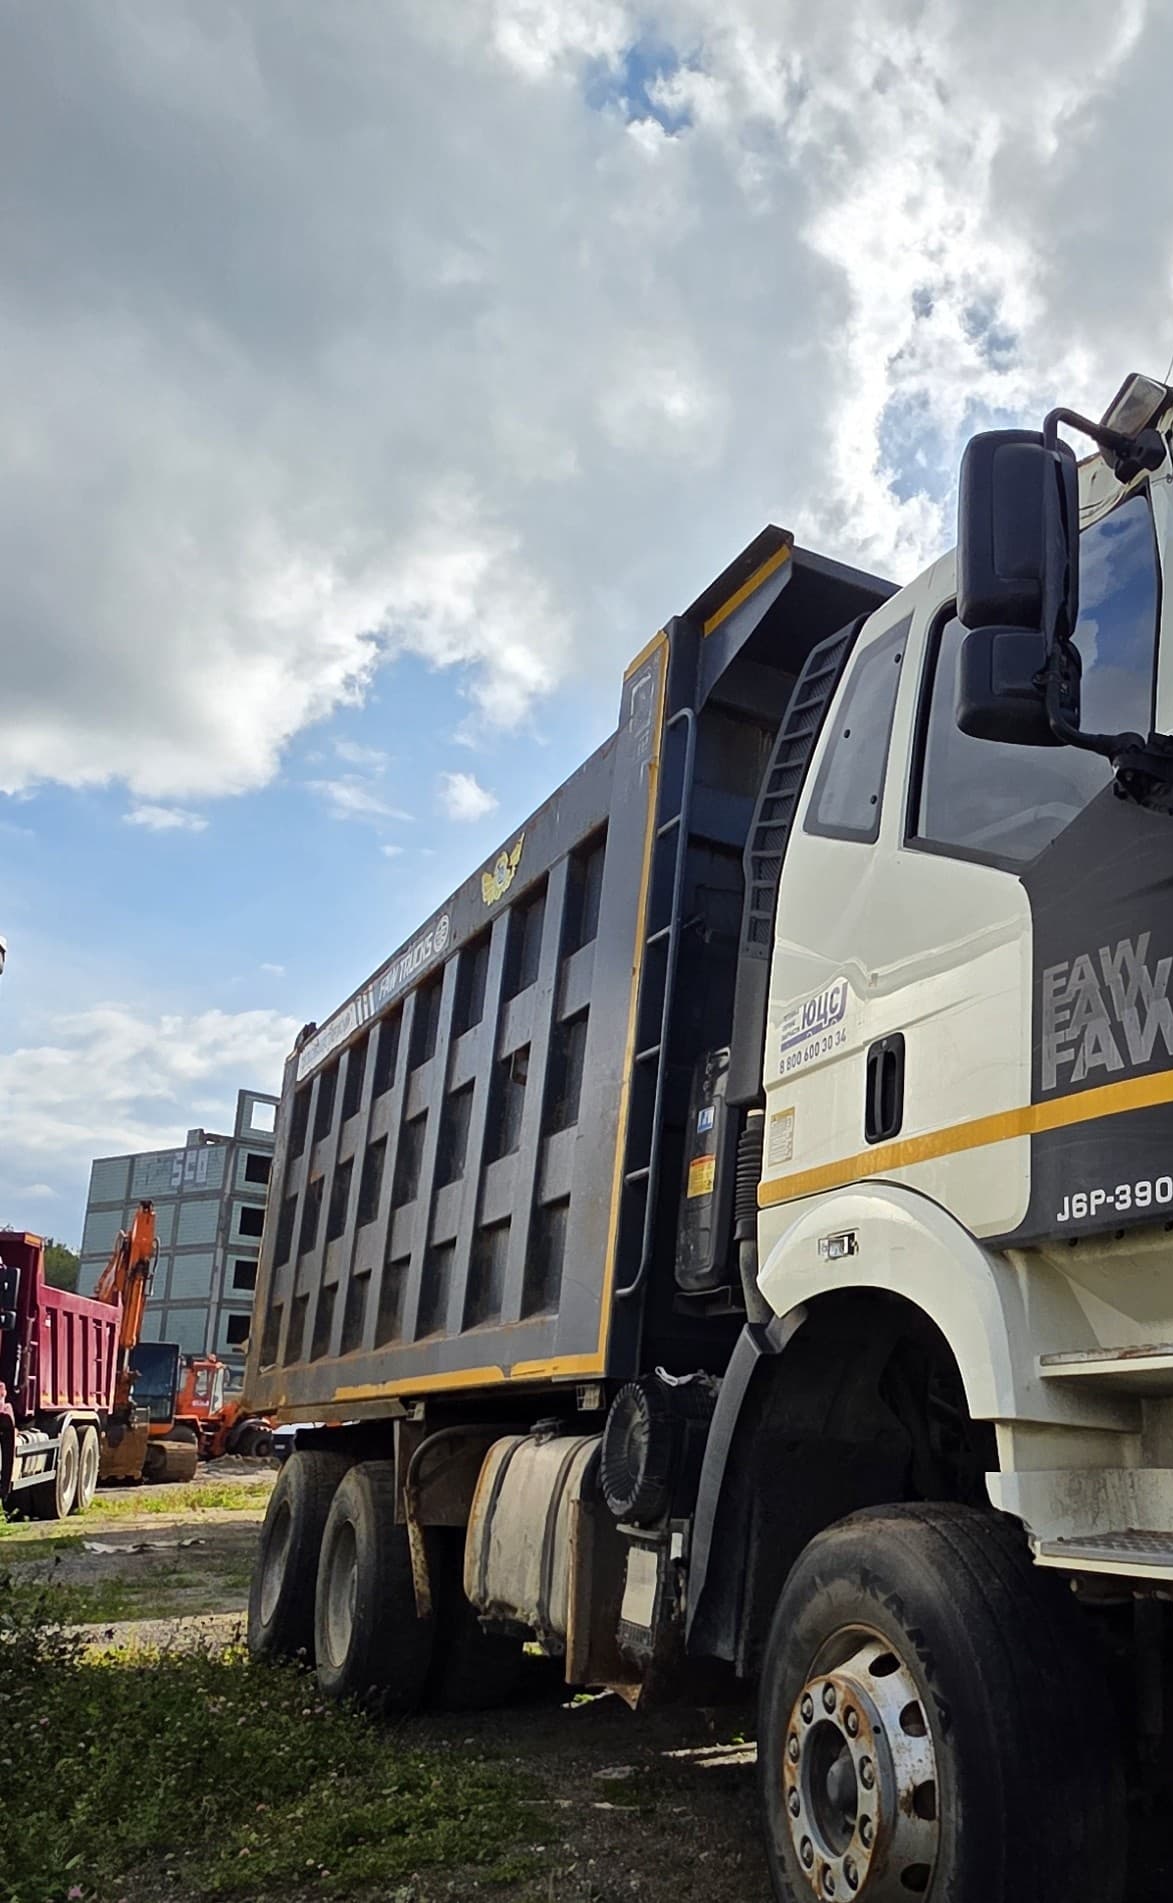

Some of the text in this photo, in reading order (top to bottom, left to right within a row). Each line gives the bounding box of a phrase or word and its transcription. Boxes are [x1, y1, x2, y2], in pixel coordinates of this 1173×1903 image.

[801, 986, 840, 1030] ЮЦС
[779, 1060, 785, 1075] 8
[786, 1050, 802, 1071] 800
[804, 1041, 820, 1062] 600
[822, 1034, 833, 1053] 30
[1056, 1176, 1173, 1222] J6P-390
